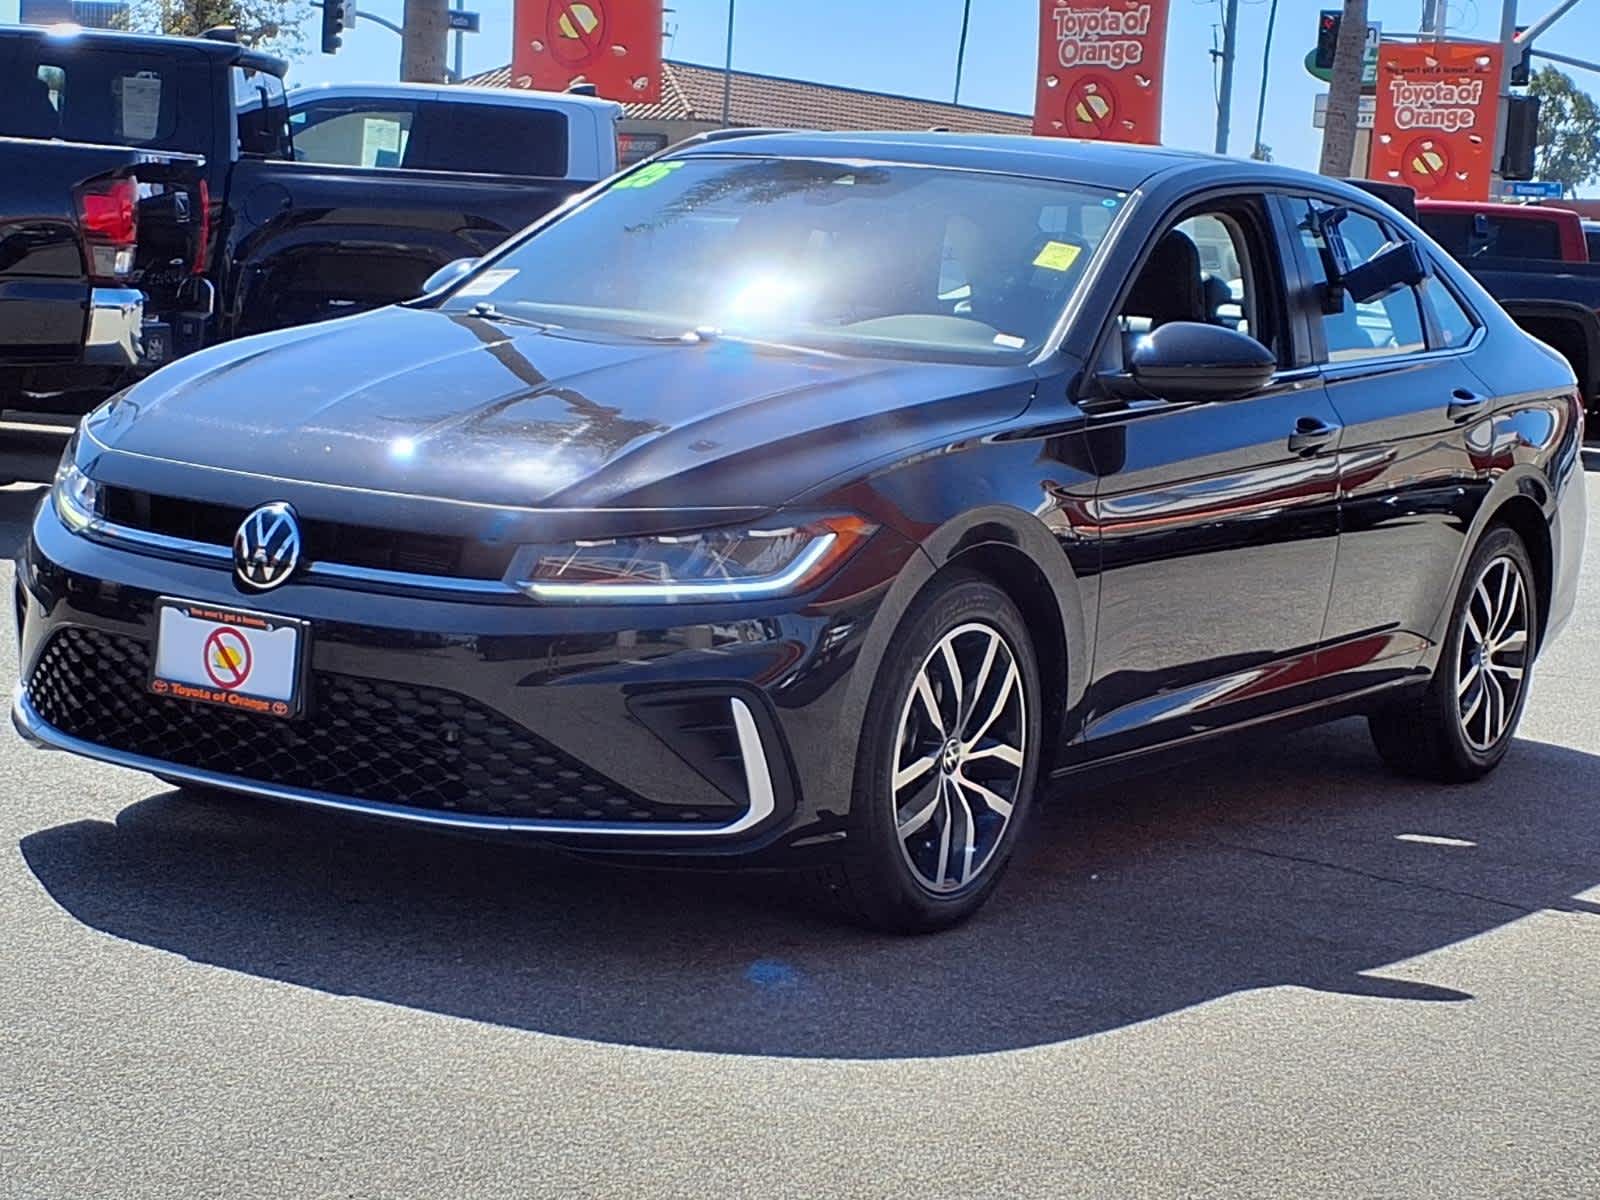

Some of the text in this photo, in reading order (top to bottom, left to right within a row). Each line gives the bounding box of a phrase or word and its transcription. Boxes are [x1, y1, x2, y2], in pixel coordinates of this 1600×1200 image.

[1053, 5, 1151, 40] Toyota of
[1059, 38, 1142, 69] Orange
[1389, 80, 1482, 106] Toyota of
[1395, 105, 1476, 132] Orange
[171, 683, 211, 699] Toyota
[212, 692, 226, 702] of
